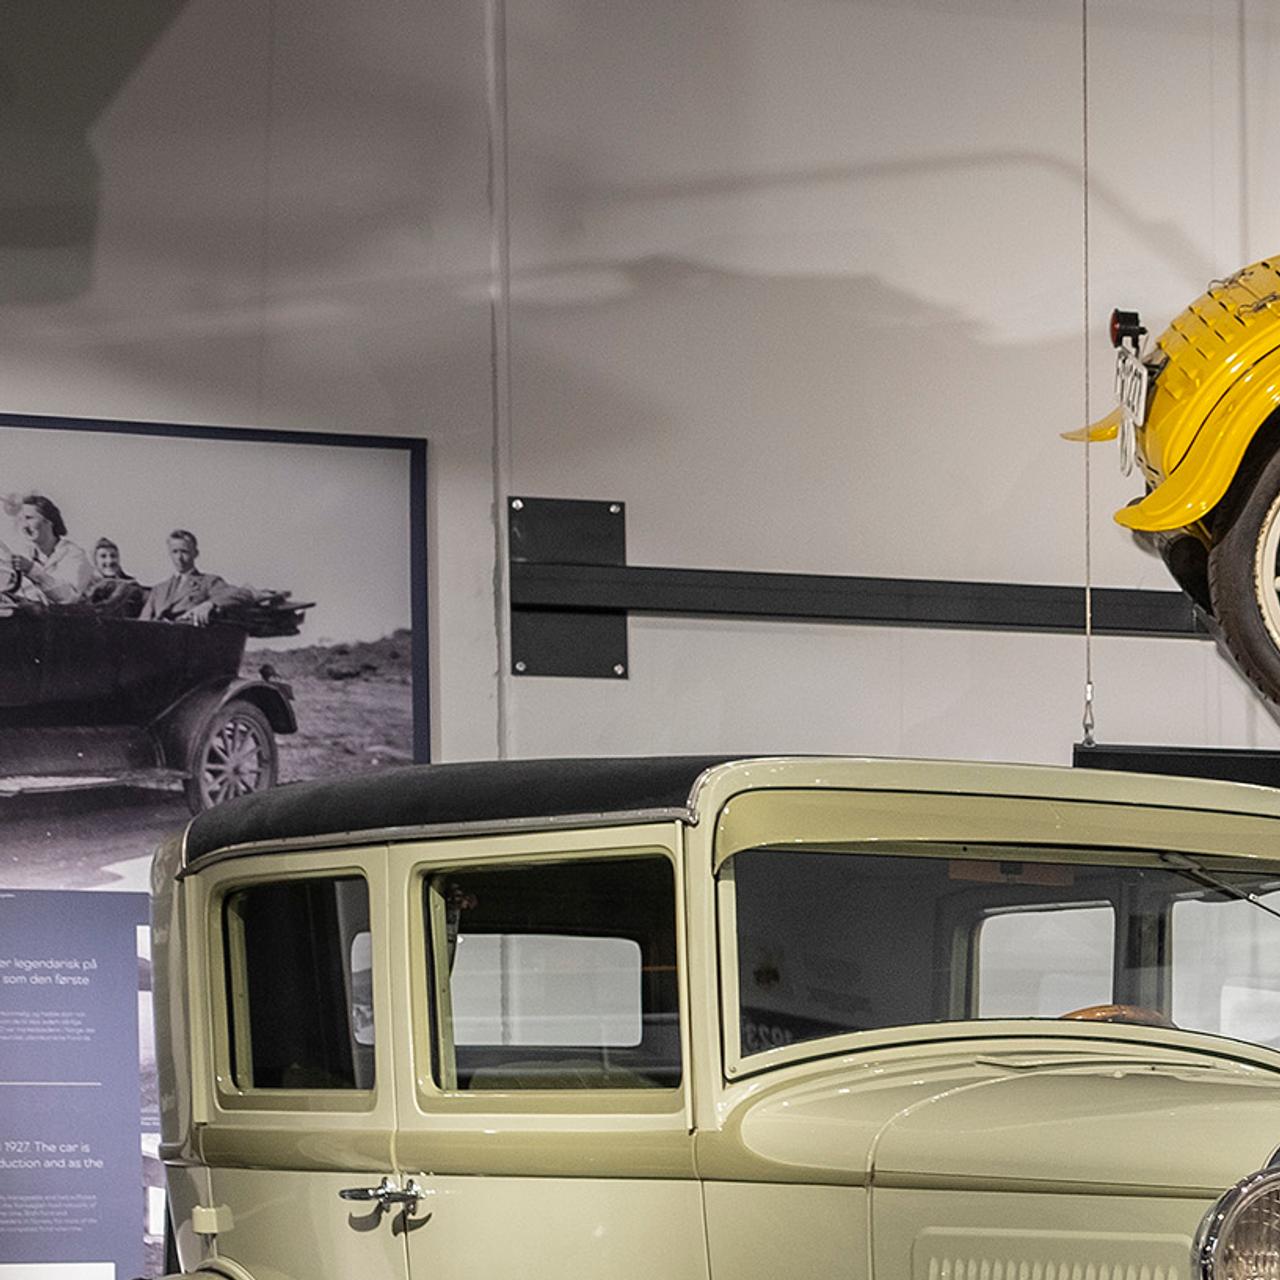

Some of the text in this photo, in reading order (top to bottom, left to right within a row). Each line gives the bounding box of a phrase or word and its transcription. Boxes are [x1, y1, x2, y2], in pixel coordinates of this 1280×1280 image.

[13, 958, 81, 972] legendarisk
[82, 958, 98, 971] på
[2, 973, 91, 986] som den første
[34, 1140, 57, 1153] The
[59, 1143, 79, 1153] car
[80, 1142, 91, 1153] is
[43, 1158, 66, 1169] and
[68, 1160, 82, 1169] as
[83, 1157, 104, 1169] the
